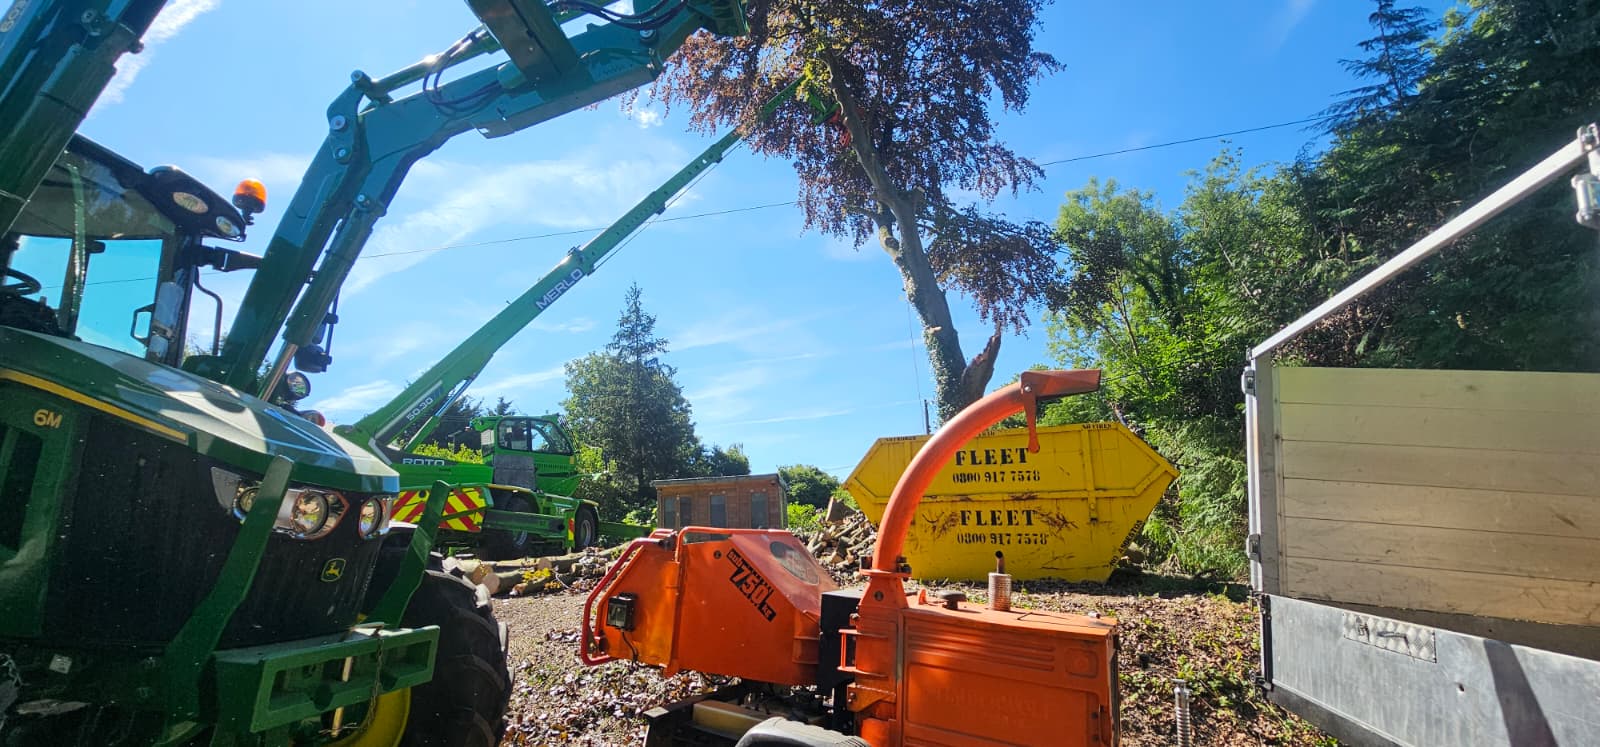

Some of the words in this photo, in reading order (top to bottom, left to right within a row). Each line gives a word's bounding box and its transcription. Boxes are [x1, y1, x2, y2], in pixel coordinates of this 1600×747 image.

[535, 268, 583, 309] MERLO
[33, 408, 63, 429] 6M
[406, 396, 433, 421] 50.30
[955, 447, 1028, 466] FLEET
[953, 472, 980, 483] 0800
[984, 471, 1005, 483] 917
[1010, 469, 1040, 482] 7578
[960, 509, 1035, 526] FLEET
[957, 532, 986, 545] 0800
[990, 533, 1011, 545] 917
[1016, 533, 1048, 545] 7578
[732, 565, 770, 606] 750
